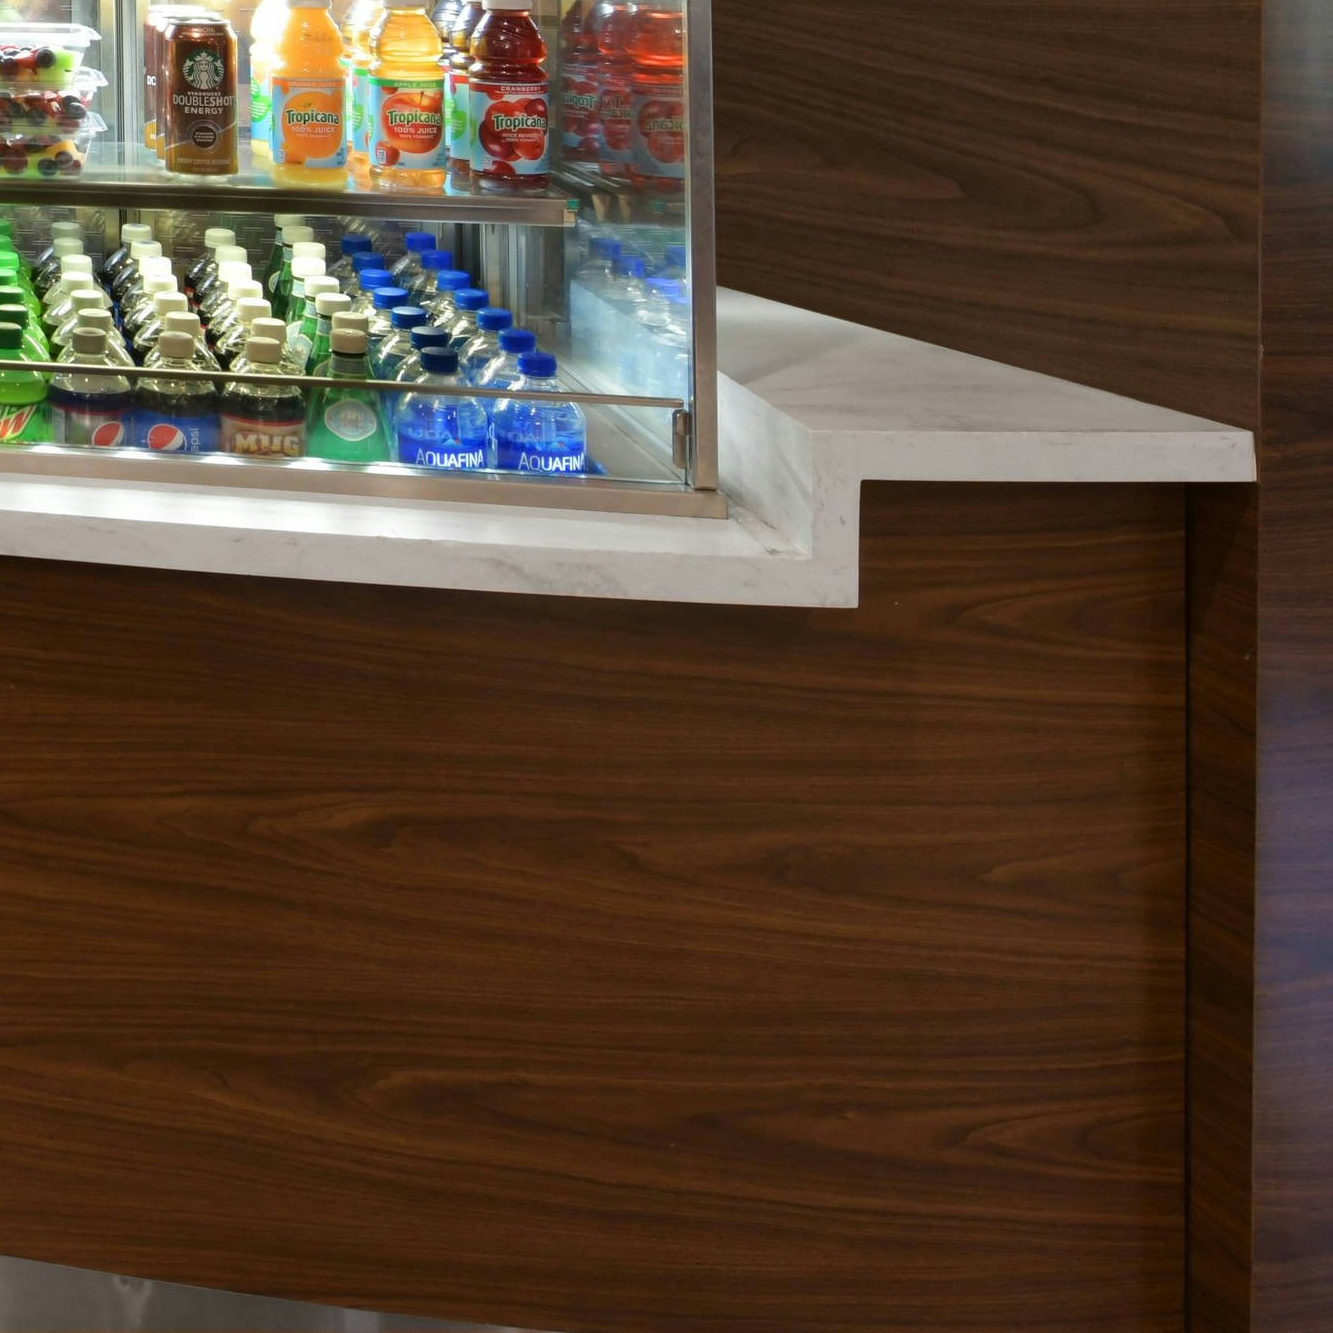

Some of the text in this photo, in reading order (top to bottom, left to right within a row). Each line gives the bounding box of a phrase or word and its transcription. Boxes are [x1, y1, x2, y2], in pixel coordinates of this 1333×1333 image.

[172, 95, 234, 107] DOUBLESHOT
[184, 107, 224, 115] ENERGY
[286, 110, 339, 125] Tropicana
[387, 110, 442, 126] Tropicana
[493, 114, 546, 132] Tropicana
[414, 127, 437, 135] JUICE
[234, 433, 300, 457] MUG
[415, 448, 485, 469] AQUAFINA
